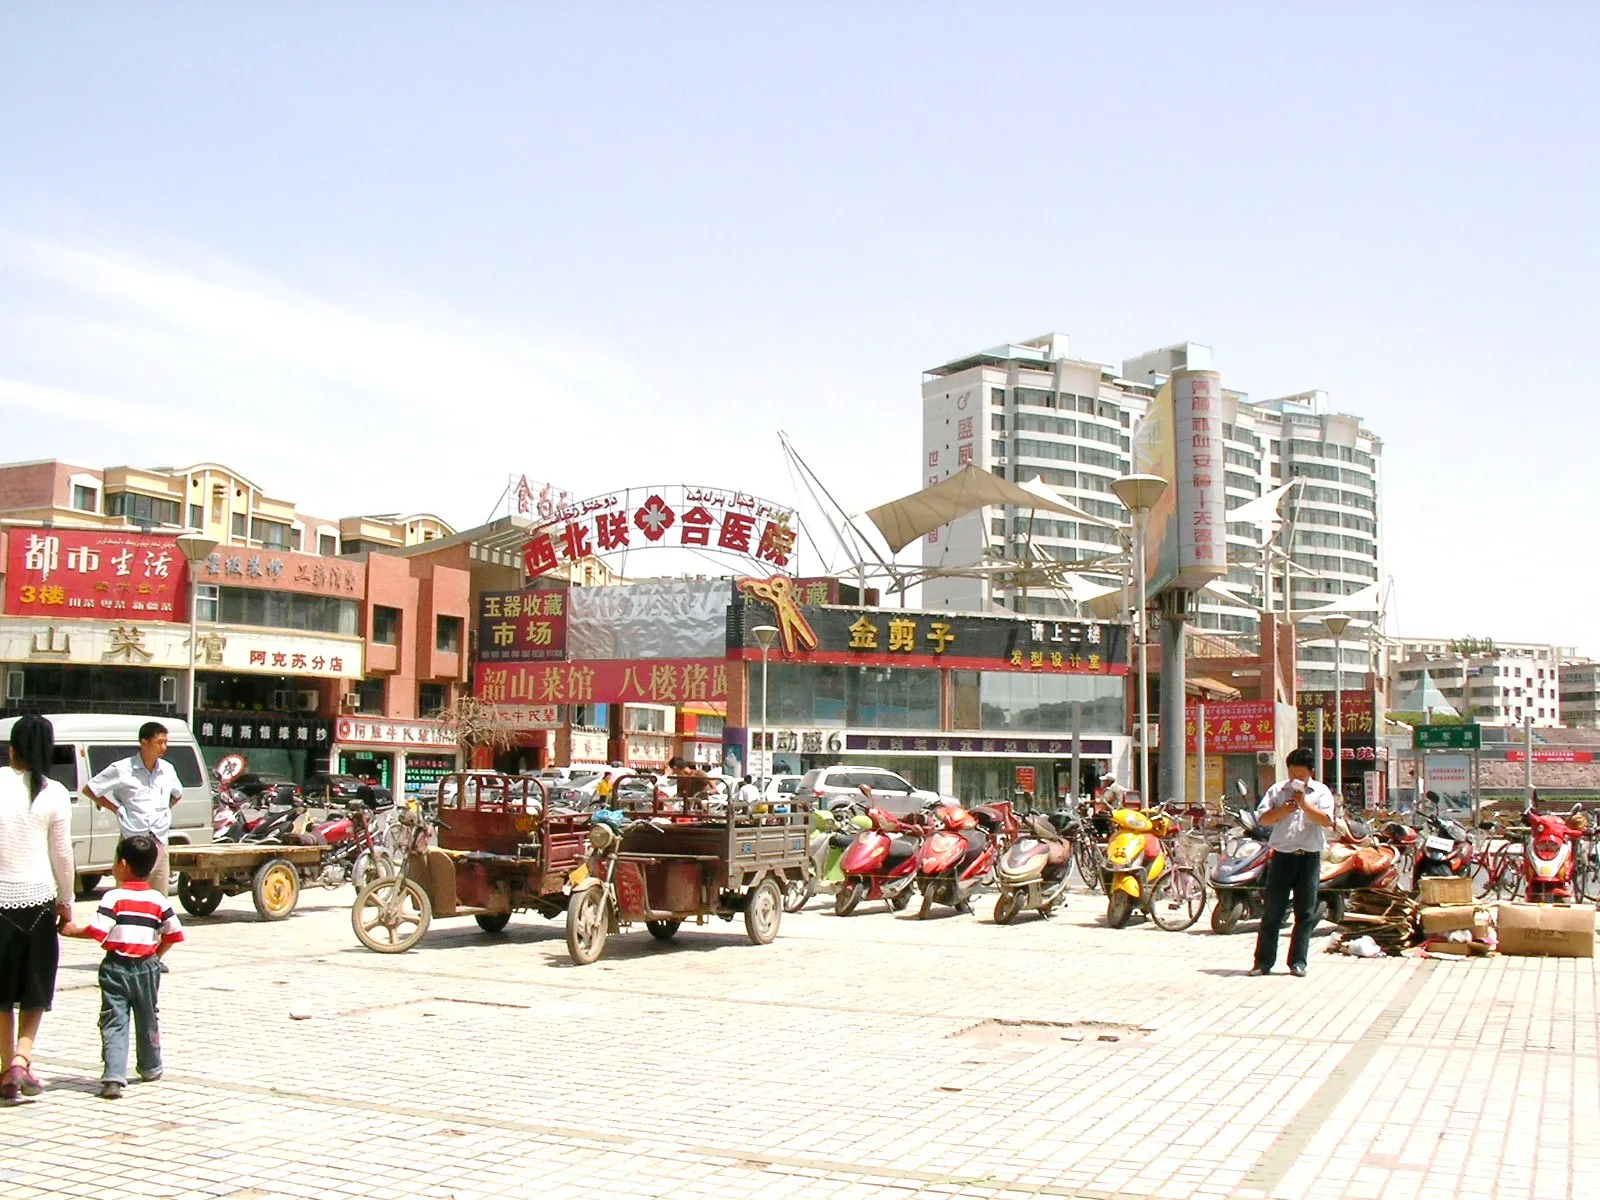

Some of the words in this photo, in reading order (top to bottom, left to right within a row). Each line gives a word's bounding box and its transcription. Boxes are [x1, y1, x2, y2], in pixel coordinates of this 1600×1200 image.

[25, 533, 174, 582] 都市生活
[19, 585, 65, 605] 3楼
[484, 593, 563, 618] 玉器收藏
[492, 621, 552, 647] 市场
[849, 614, 955, 654] 金剪子
[1030, 620, 1100, 644] 请上二楼
[250, 649, 343, 672] 阿克苏分店
[1010, 650, 1100, 669] 发型设计室
[481, 665, 596, 701] 韶山菜馆
